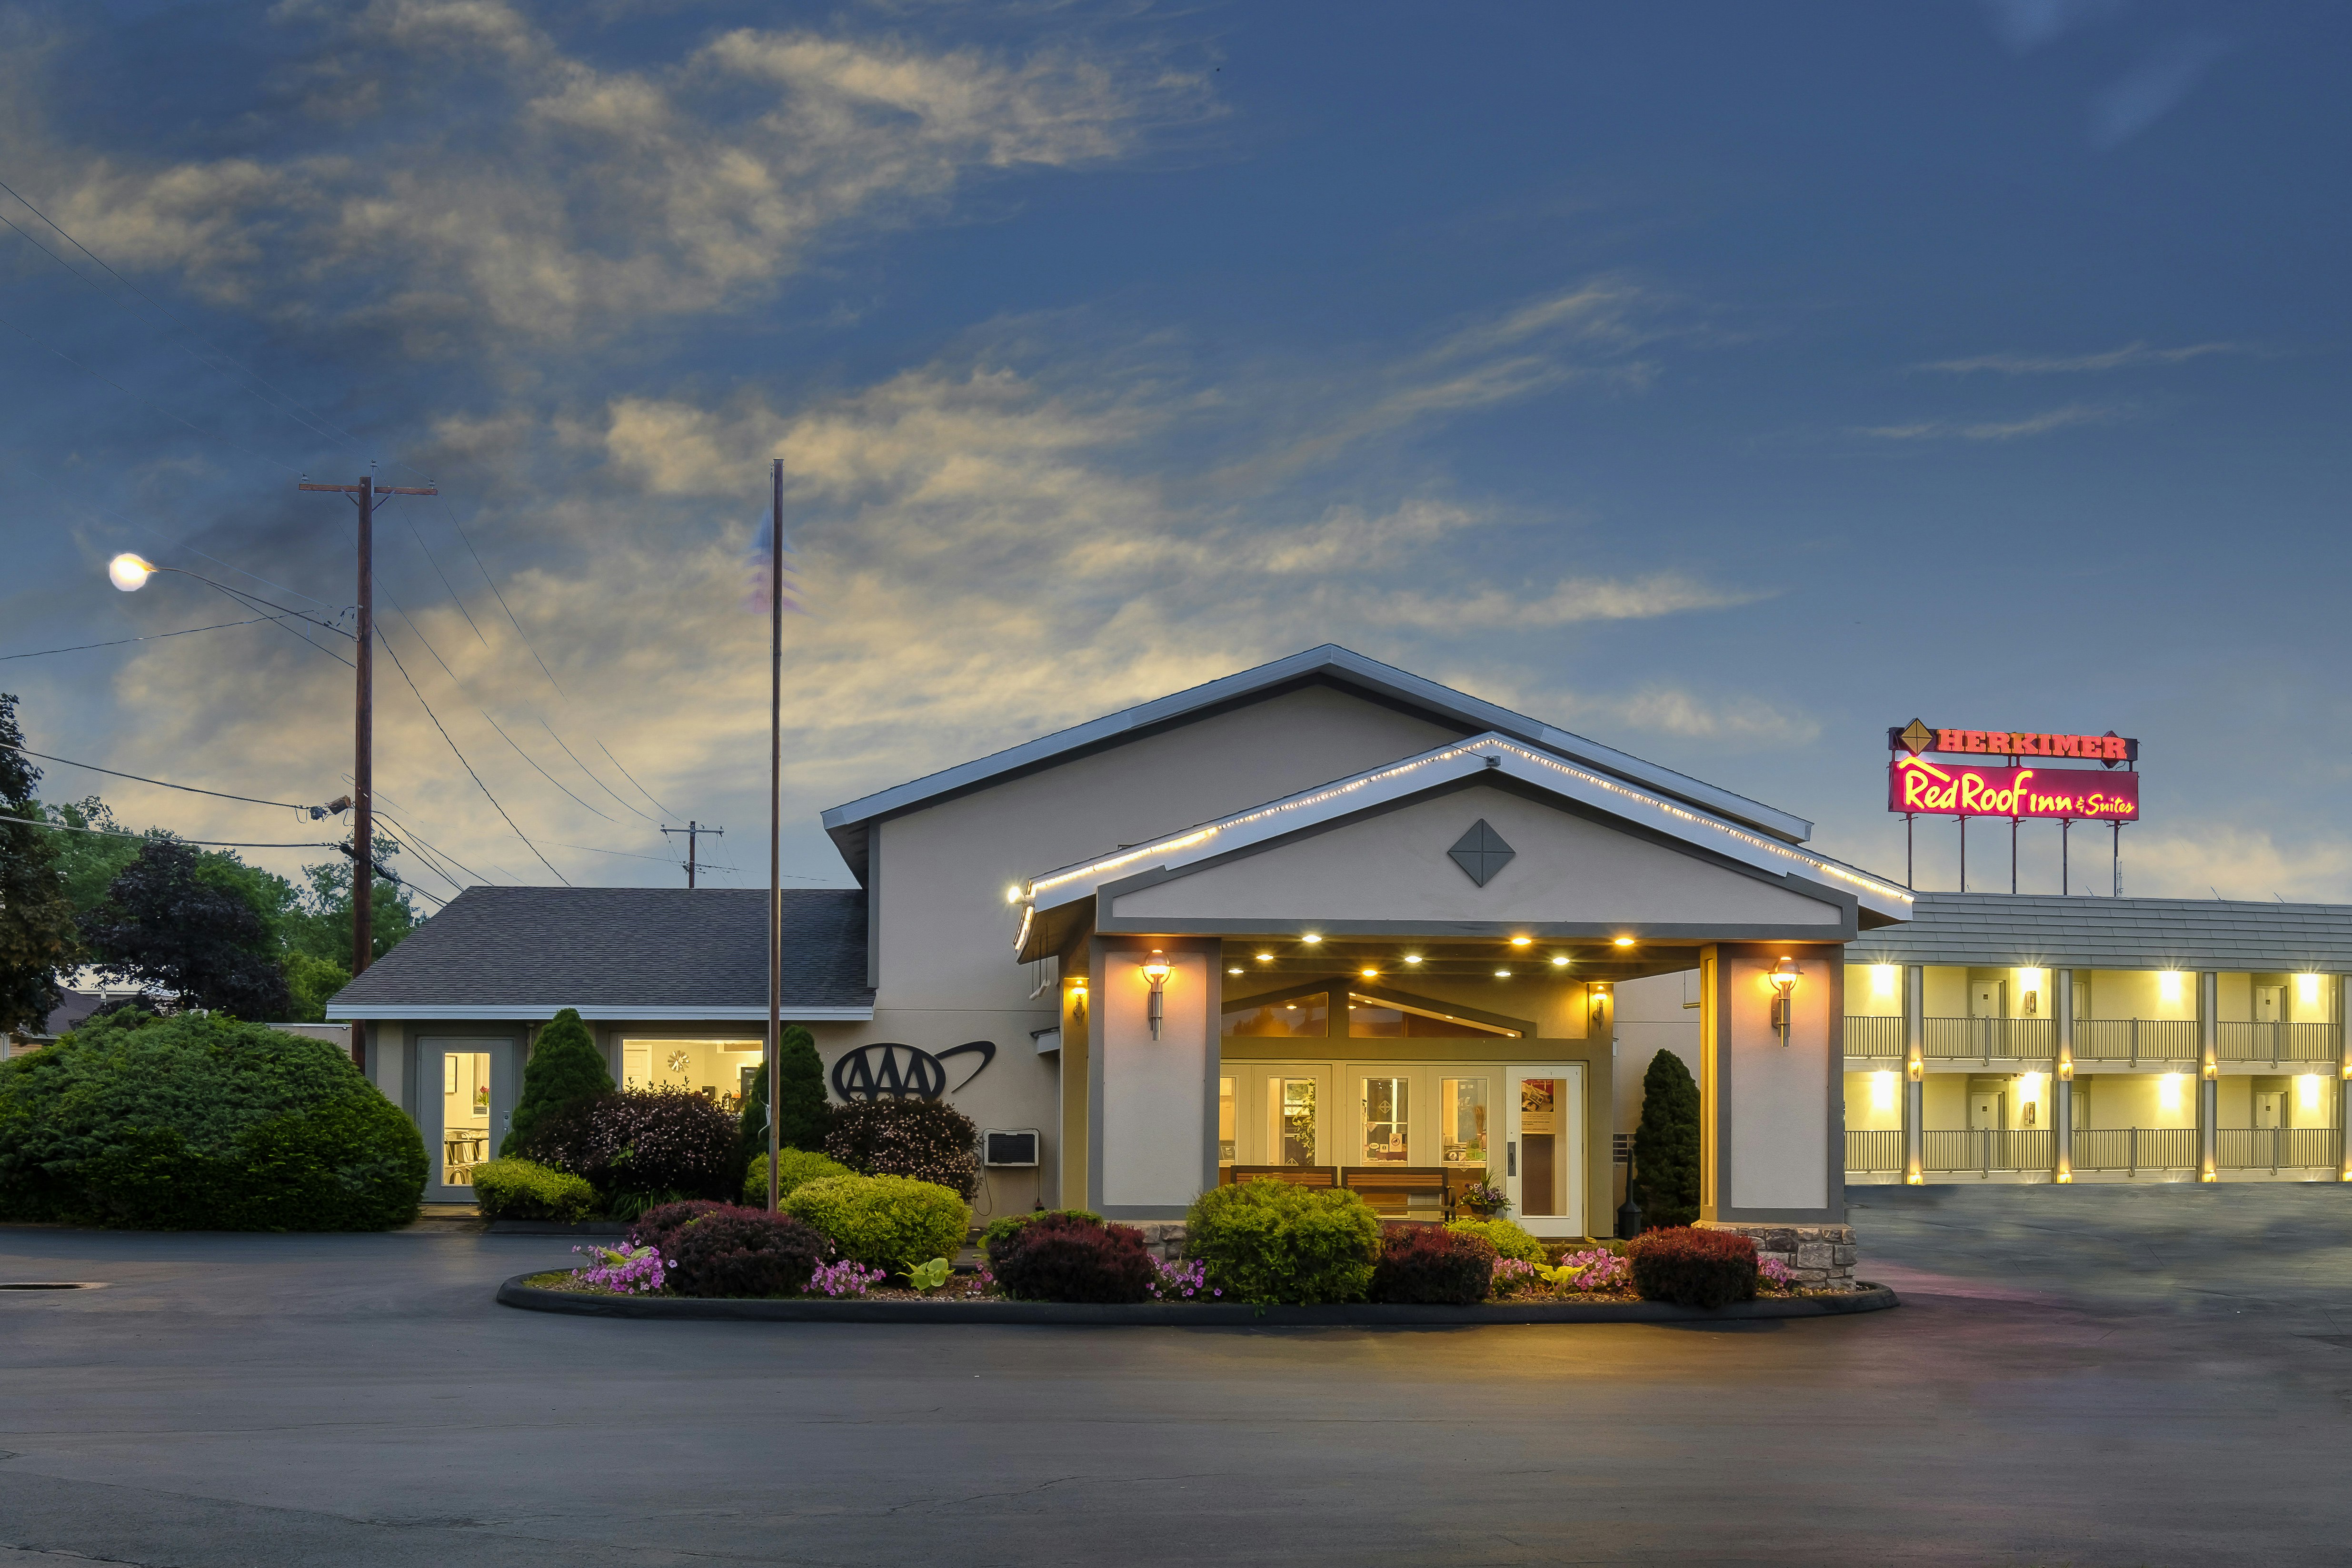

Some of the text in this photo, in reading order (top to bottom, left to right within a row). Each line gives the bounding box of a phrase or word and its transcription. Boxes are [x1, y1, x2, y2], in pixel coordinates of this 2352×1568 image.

[1936, 729, 2127, 759] HERKIMER
[2075, 796, 2084, 813] &
[2085, 794, 2134, 815] Suites
[841, 1043, 936, 1104] AAA
